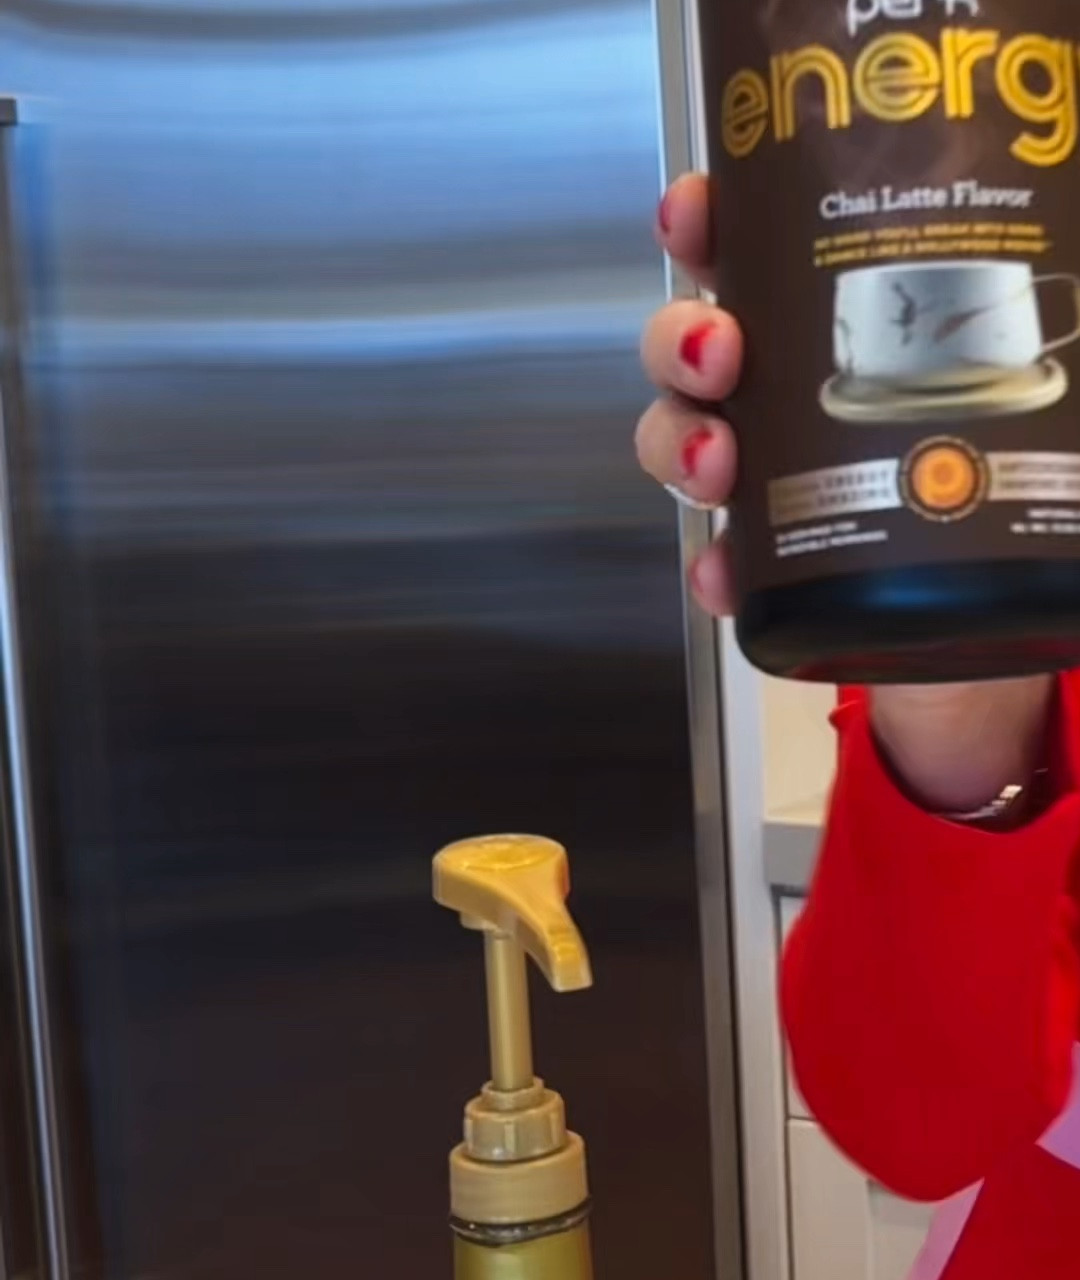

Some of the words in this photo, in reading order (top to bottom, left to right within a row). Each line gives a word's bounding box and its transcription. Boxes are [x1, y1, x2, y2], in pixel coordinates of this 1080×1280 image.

[819, 190, 877, 218] Chai
[881, 184, 948, 211] Latte
[952, 179, 1034, 208] Flavor
